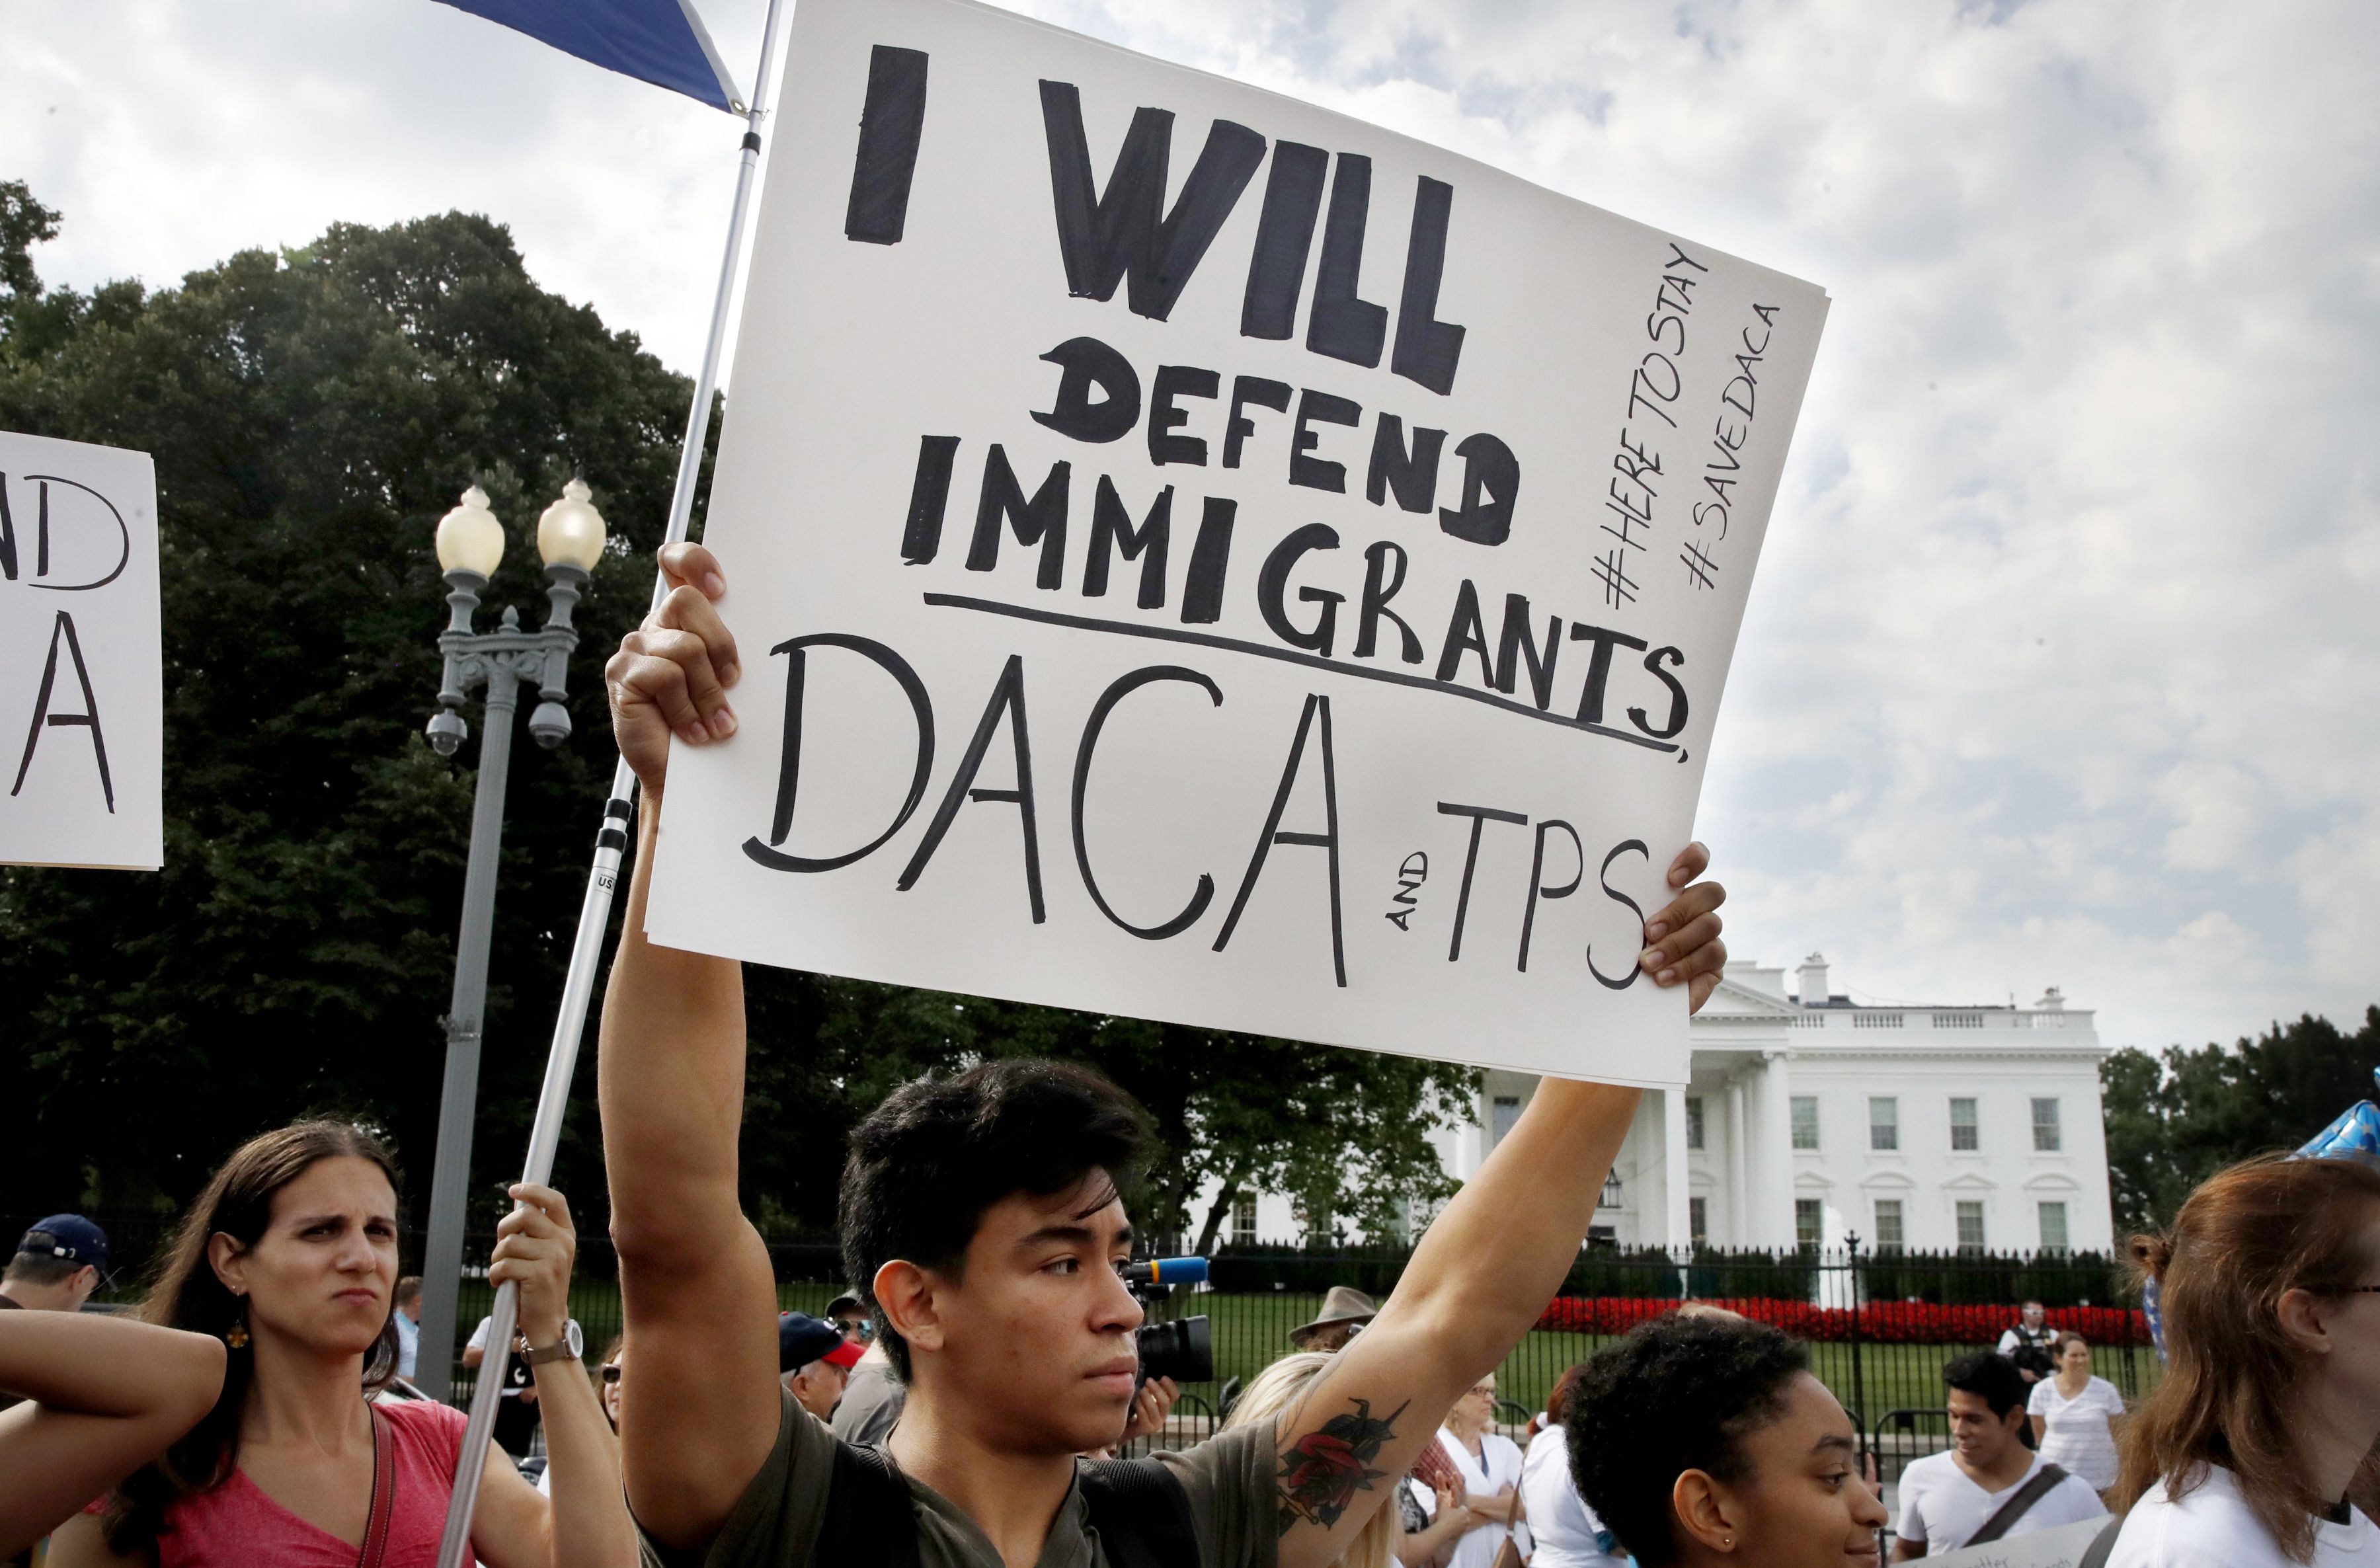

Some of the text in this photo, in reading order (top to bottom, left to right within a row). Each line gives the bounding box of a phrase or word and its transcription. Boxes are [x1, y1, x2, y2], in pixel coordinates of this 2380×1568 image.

[844, 44, 1466, 397] I WILL
[1030, 336, 1521, 547] DEFEND
[1679, 303, 1780, 590] #SAVEDACA
[742, 633, 1649, 991] DACA AND TPS
